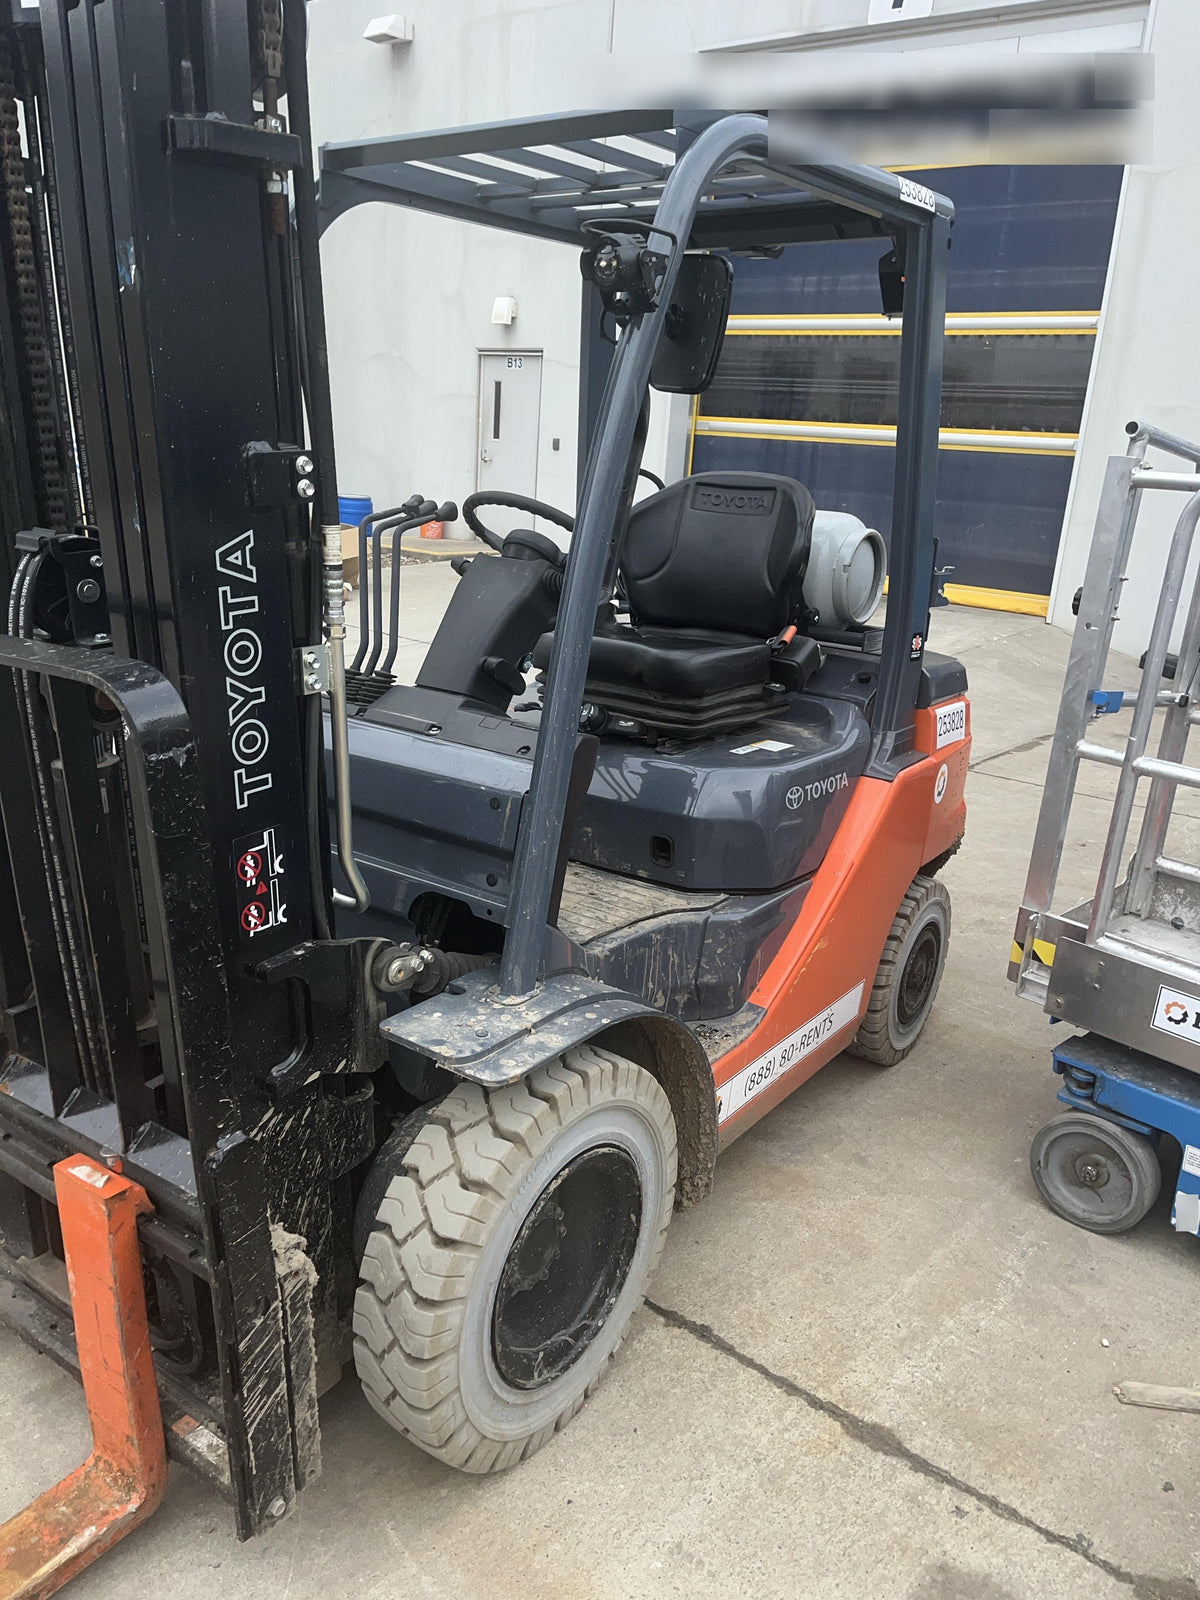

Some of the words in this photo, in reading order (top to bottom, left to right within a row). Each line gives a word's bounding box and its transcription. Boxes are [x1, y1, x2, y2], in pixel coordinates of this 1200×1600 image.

[899, 178, 934, 208] 253828
[507, 357, 523, 369] B13
[701, 492, 768, 509] TOYOTA
[12, 572, 21, 590] WIRE
[215, 529, 272, 809] TOYOTA
[938, 709, 964, 737] 253828
[805, 772, 848, 801] TOYOTA
[744, 1057, 776, 1097] (888)
